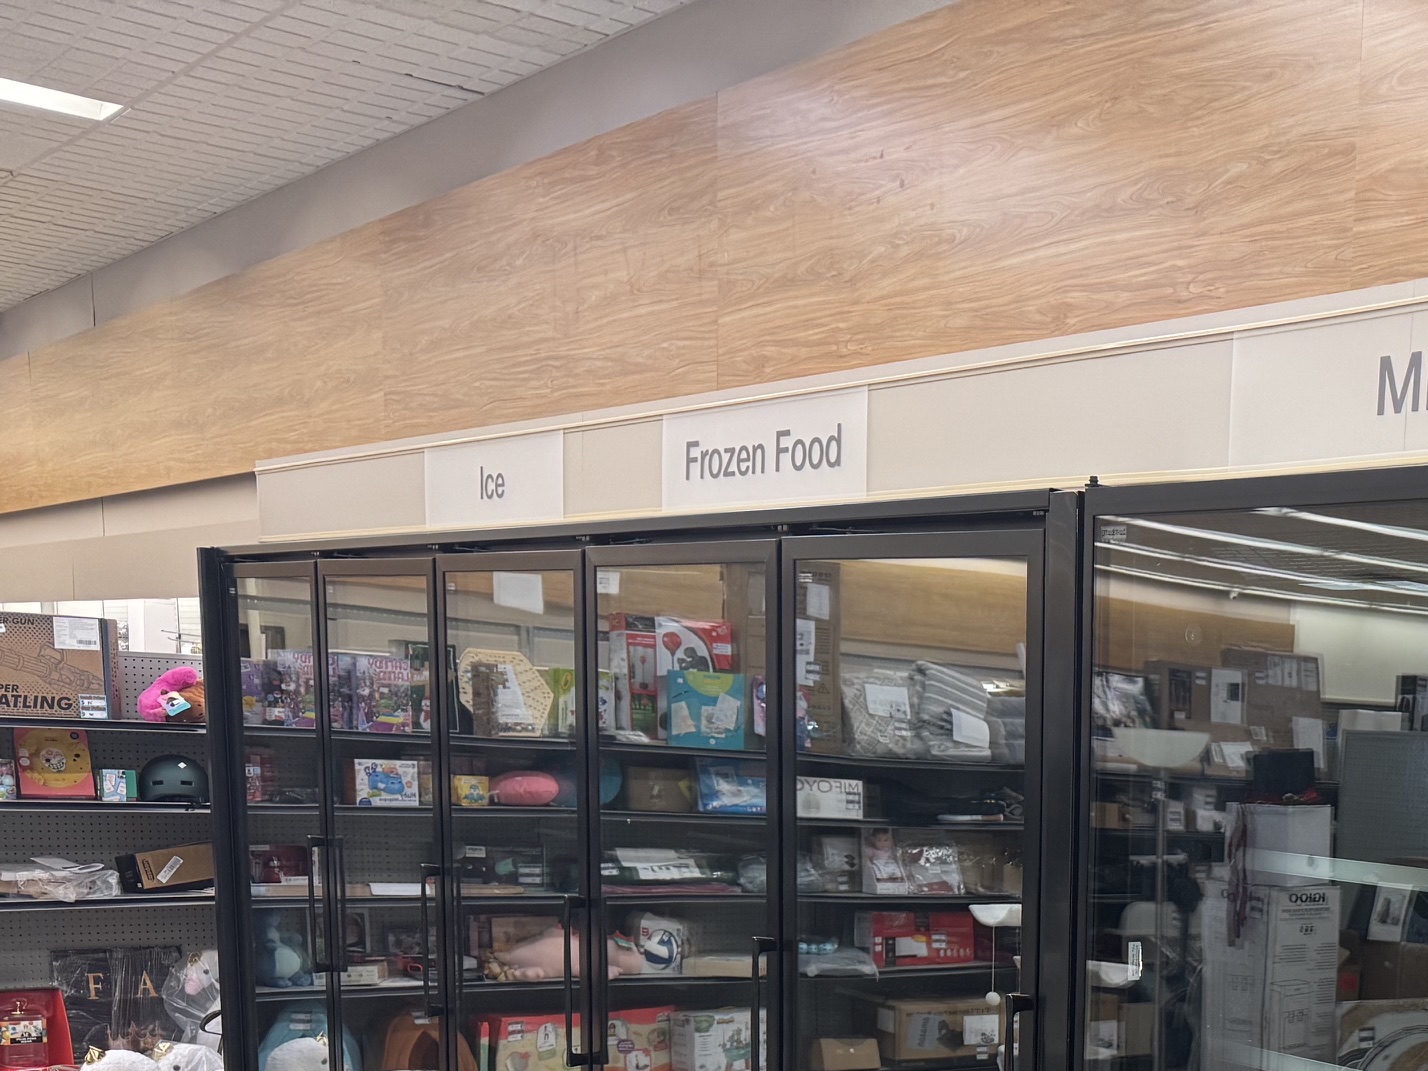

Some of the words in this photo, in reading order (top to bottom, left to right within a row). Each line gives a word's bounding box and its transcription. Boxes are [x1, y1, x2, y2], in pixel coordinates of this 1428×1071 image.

[685, 440, 766, 481] Frozen
[774, 422, 842, 473] Food
[479, 466, 505, 500] Ice
[12, 617, 35, 626] GUN
[85, 973, 104, 1000] F
[135, 970, 158, 998] A
